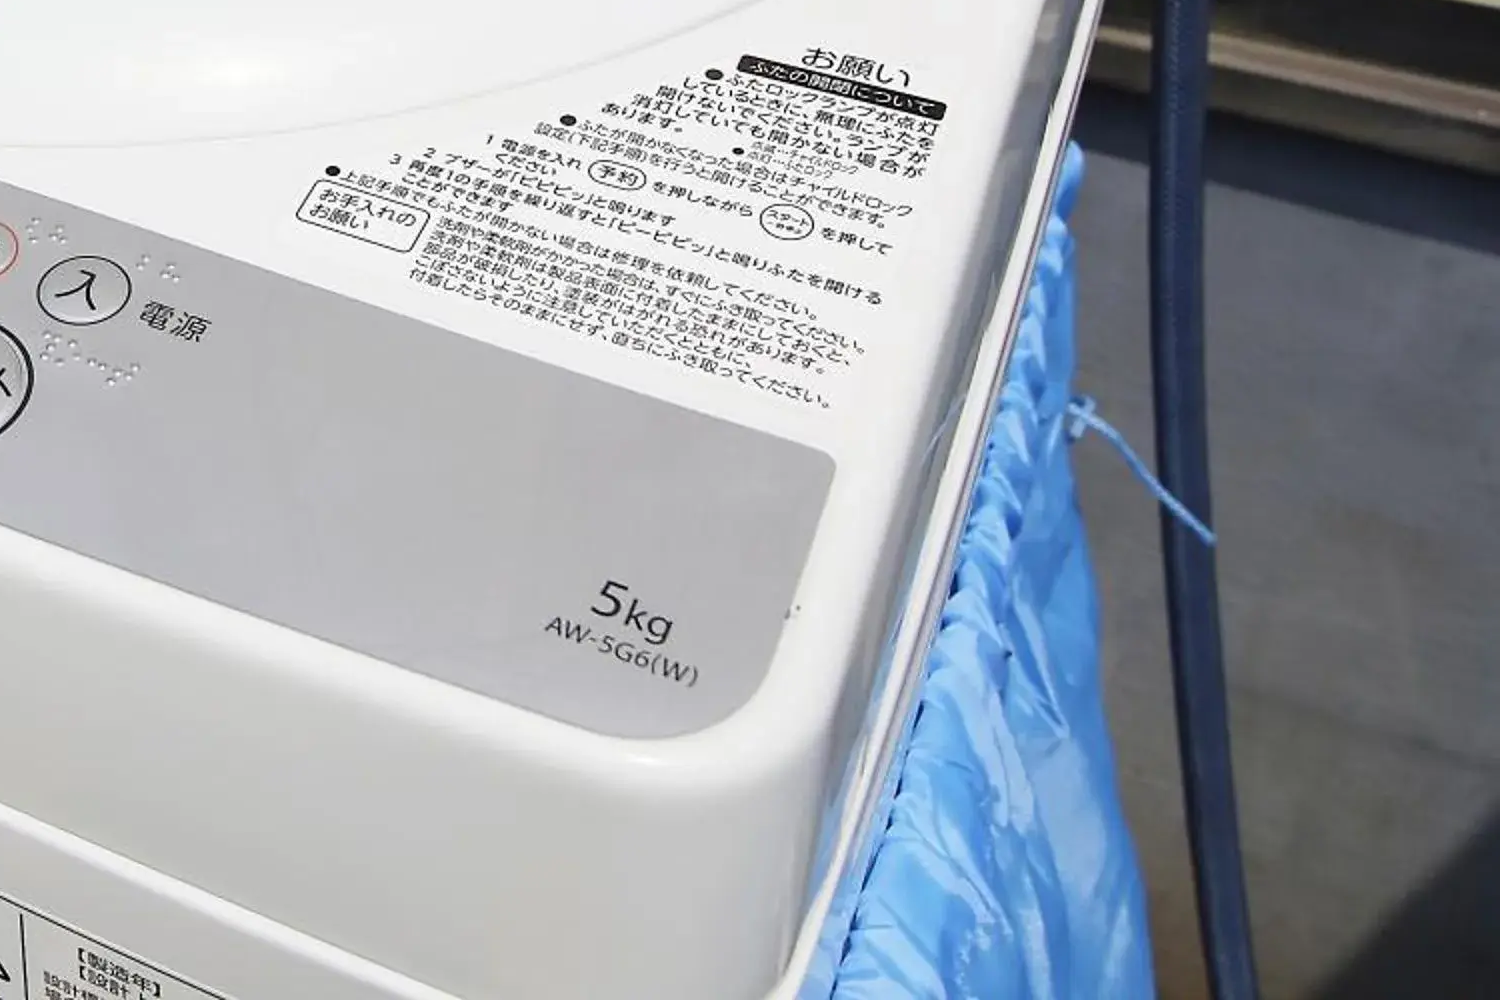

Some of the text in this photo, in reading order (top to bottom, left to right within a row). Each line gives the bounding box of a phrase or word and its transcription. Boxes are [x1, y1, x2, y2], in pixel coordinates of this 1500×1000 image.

[802, 47, 911, 88] お願い
[750, 62, 937, 117] ふたの開閉について
[601, 102, 683, 133] あります。
[495, 152, 558, 177] ください
[308, 203, 370, 231] お願い
[319, 188, 417, 228] お手入れの
[54, 268, 97, 311] 入
[138, 300, 212, 343] 電源
[590, 579, 674, 646] 5kg
[544, 615, 699, 688] AW-5G6(W)
